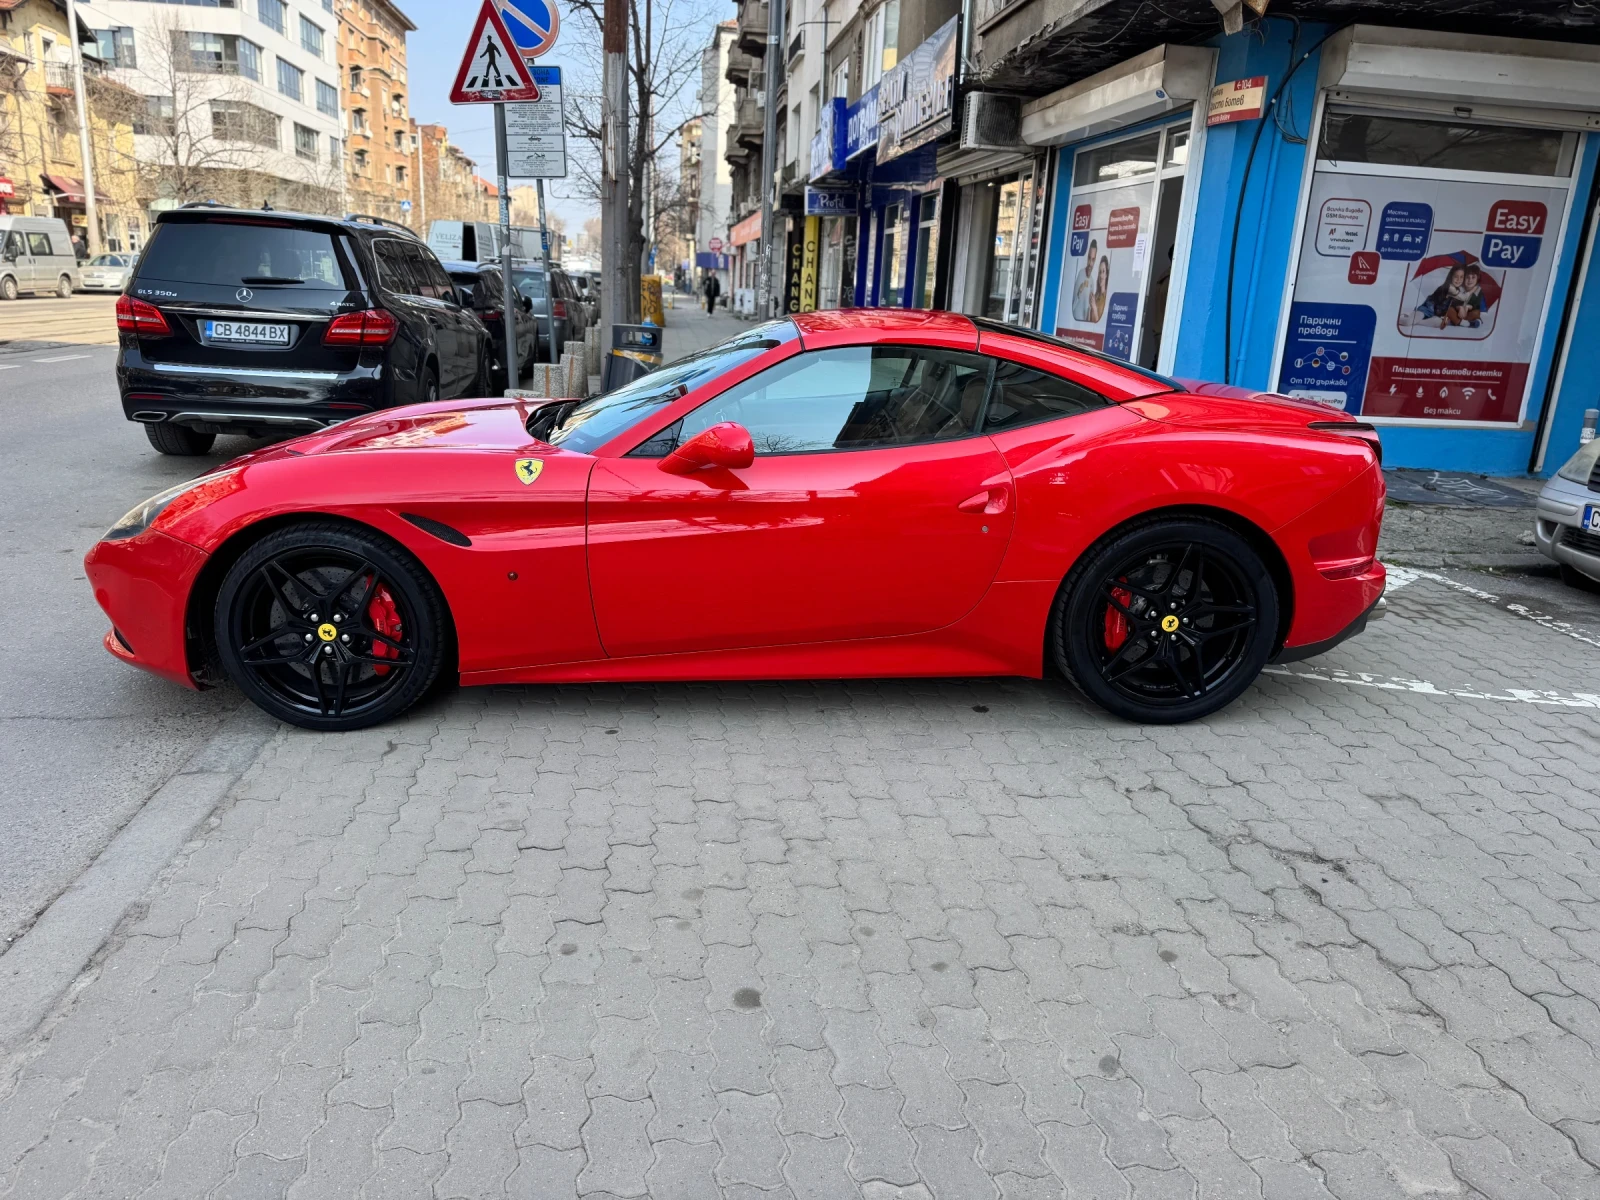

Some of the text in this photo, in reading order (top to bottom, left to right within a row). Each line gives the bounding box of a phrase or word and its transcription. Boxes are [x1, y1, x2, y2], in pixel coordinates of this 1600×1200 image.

[818, 193, 846, 209] Profil
[1074, 211, 1090, 228] Easy
[1494, 208, 1541, 233] Easy
[1328, 227, 1337, 235] A1
[1072, 235, 1084, 253] Pay
[1488, 239, 1525, 264] Pay
[790, 244, 802, 312] CHANG
[803, 241, 816, 312] CHANG
[154, 290, 178, 298] 350d
[1300, 315, 1342, 326] Парични
[214, 323, 232, 336] CB
[235, 324, 267, 338] 4844
[269, 326, 287, 340] BX
[1298, 326, 1339, 336] преводи
[1392, 365, 1430, 375] Плащане
[1442, 367, 1471, 376] битови
[1304, 377, 1315, 385] 170
[1316, 378, 1348, 386] държави
[1424, 406, 1461, 415] Без такси
